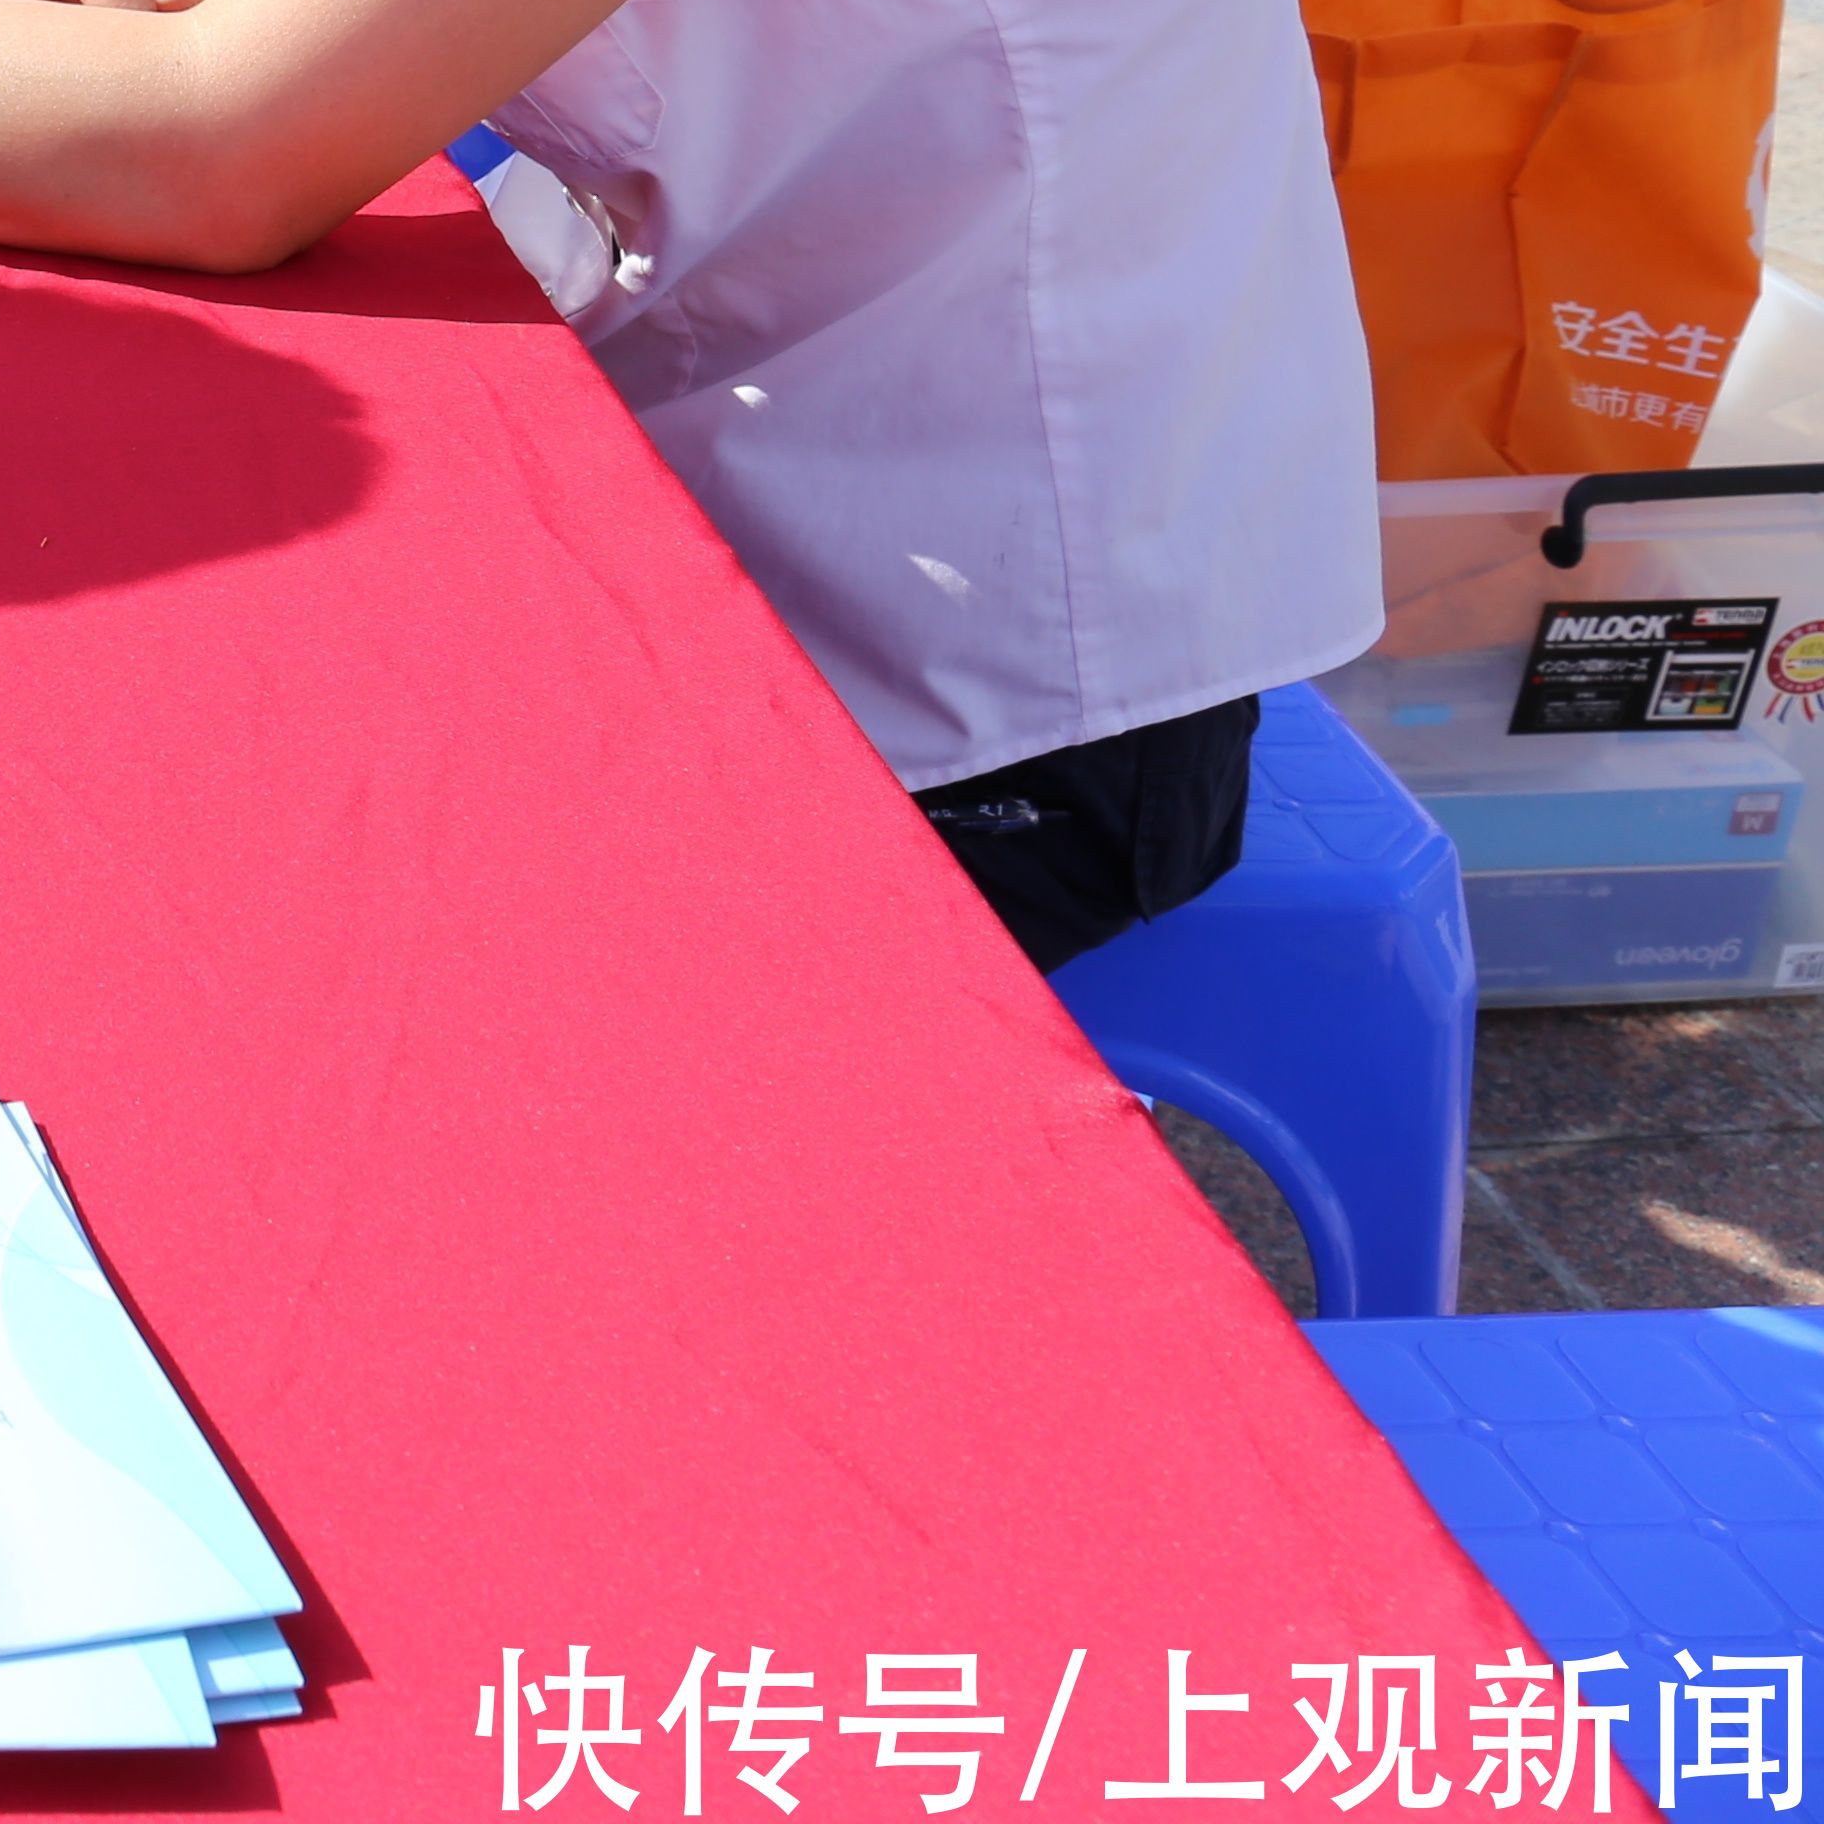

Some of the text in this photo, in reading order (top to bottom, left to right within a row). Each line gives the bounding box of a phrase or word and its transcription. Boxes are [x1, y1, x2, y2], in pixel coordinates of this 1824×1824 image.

[1551, 300, 1744, 382] 安全生
[1545, 611, 1674, 642] INLOCK
[1615, 938, 1744, 971] gloveen
